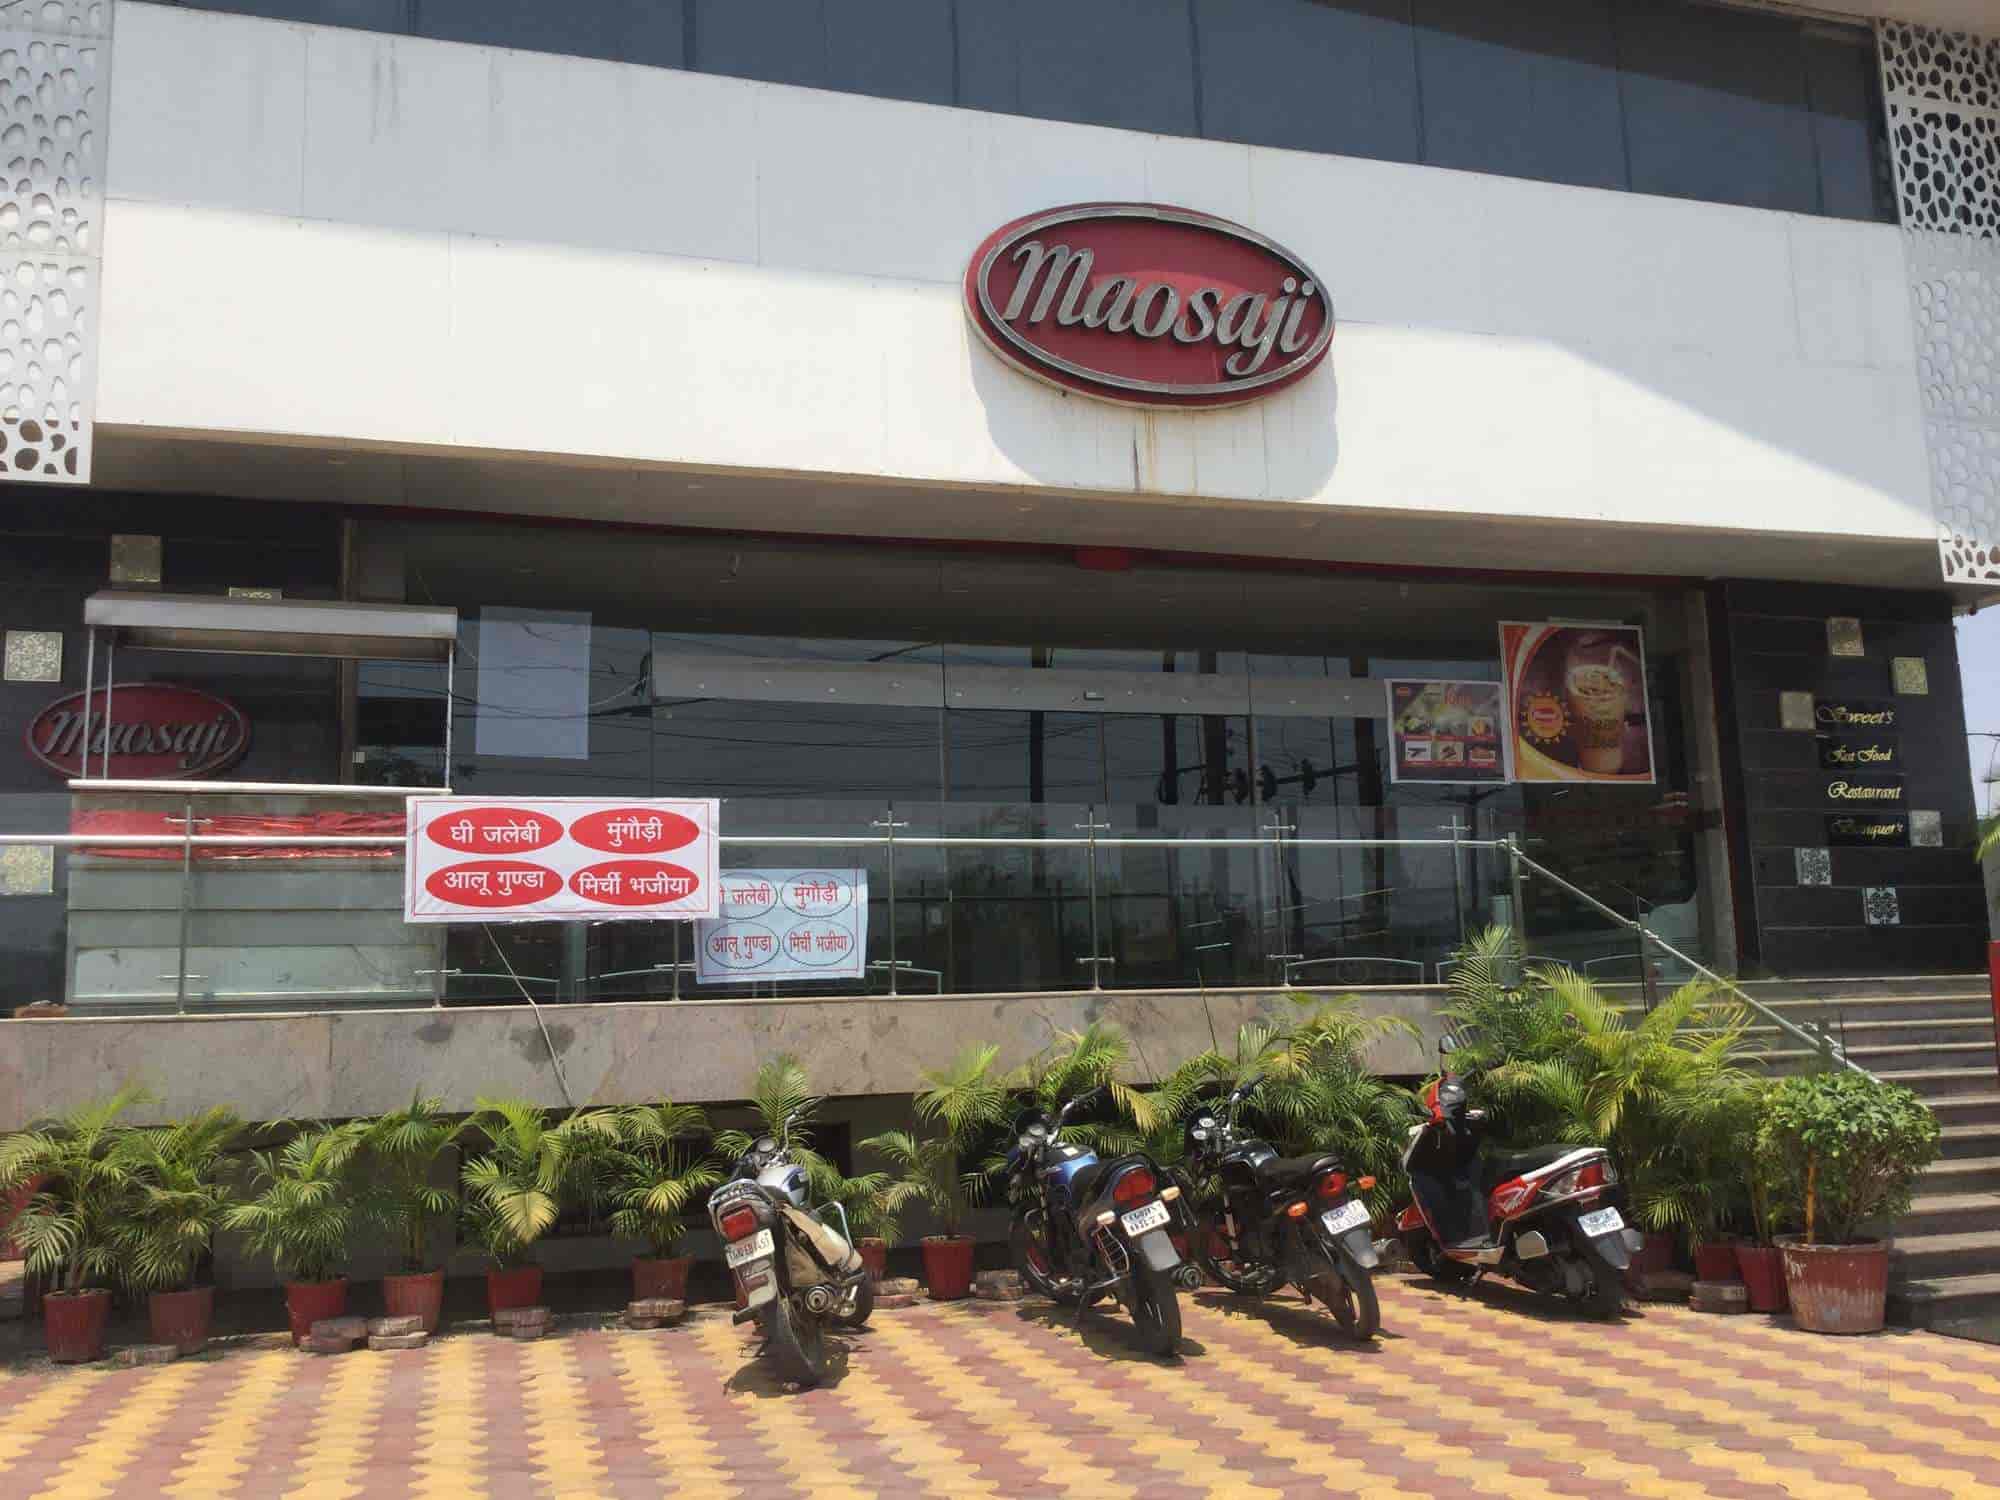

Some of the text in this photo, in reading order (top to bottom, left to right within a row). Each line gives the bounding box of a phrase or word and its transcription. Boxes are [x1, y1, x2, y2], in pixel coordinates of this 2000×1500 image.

[1001, 240, 1316, 376] Maosaji
[45, 711, 232, 769] Maosaji
[1857, 744, 1893, 762] Food
[1828, 781, 1902, 799] Restaurant
[450, 819, 541, 843] घी जलेबी
[445, 871, 546, 896] आलू गुण्डा
[578, 871, 690, 895] मिर्ची भजीया
[731, 883, 770, 905] जलेबी
[712, 935, 741, 960] आलू
